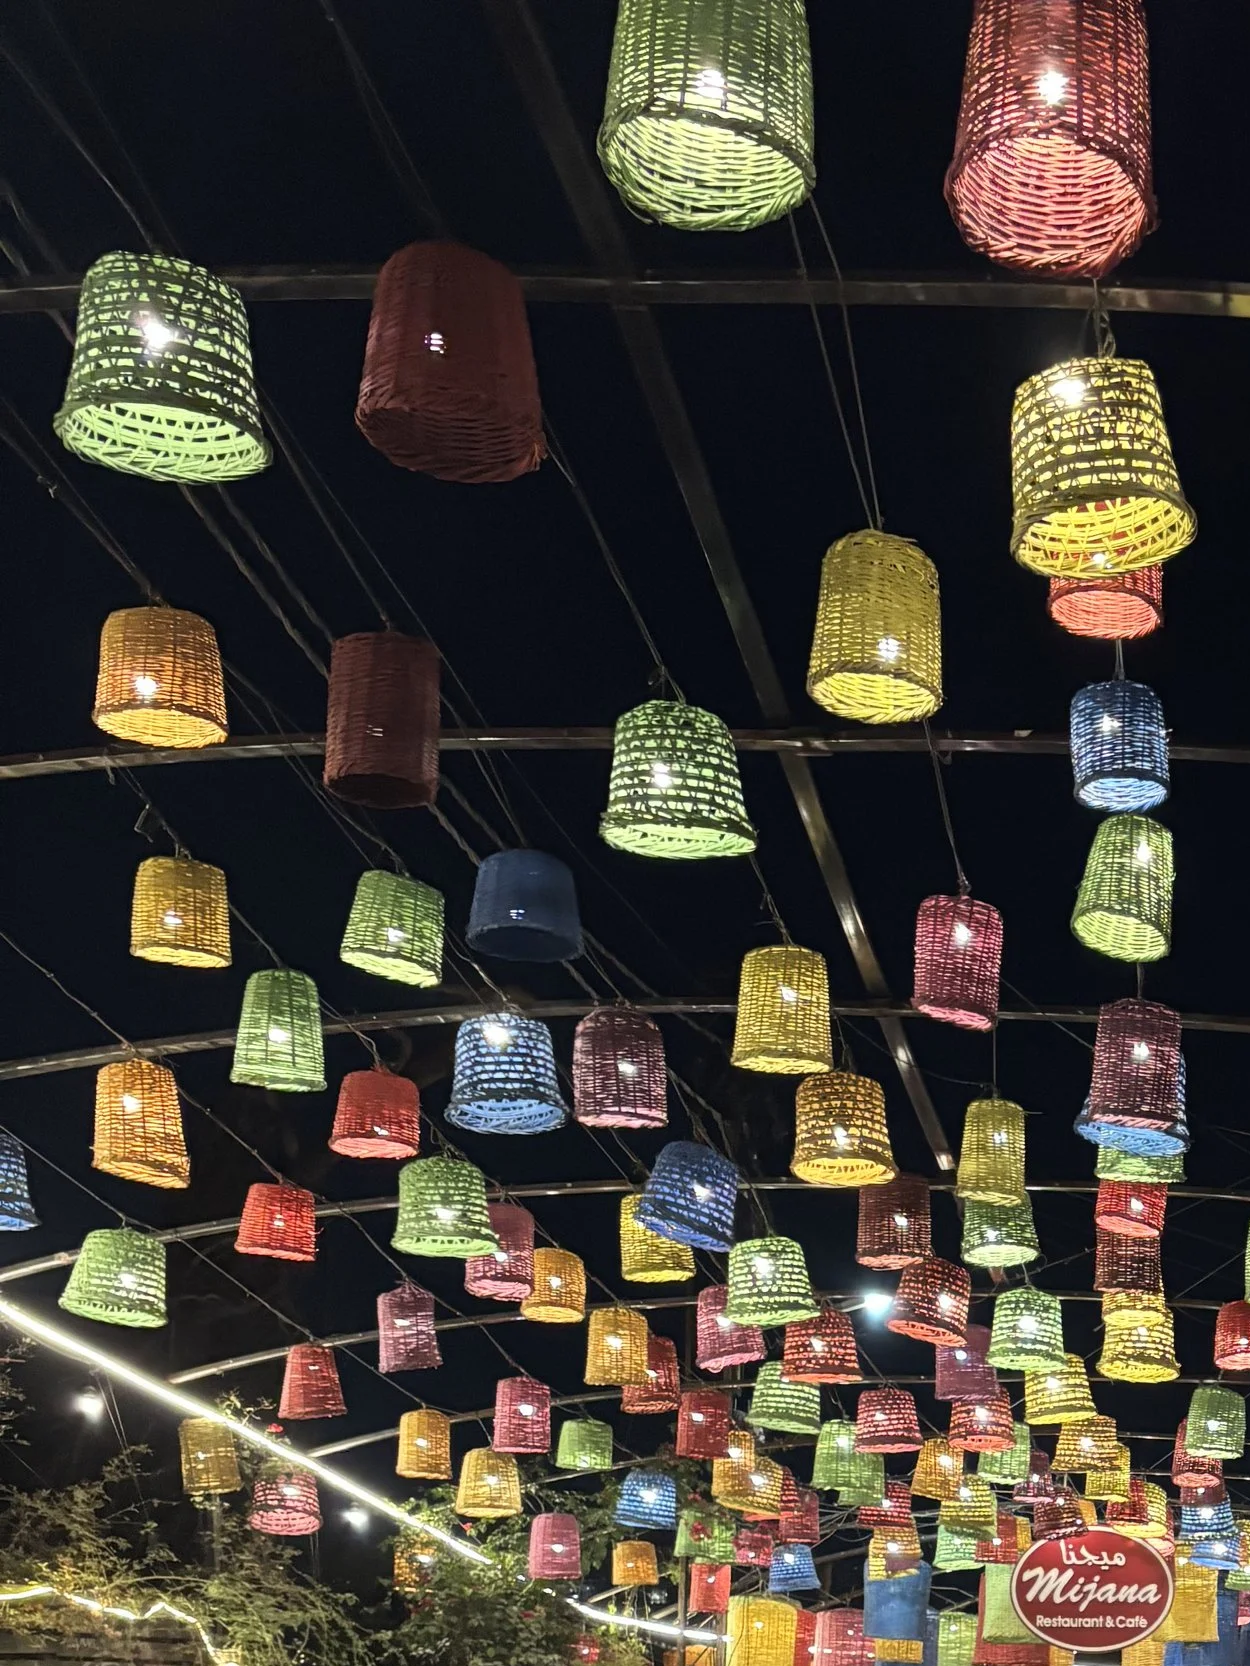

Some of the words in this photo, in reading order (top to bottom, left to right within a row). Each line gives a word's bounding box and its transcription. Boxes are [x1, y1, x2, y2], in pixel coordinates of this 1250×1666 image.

[1059, 1539, 1127, 1571] ميجنا
[1022, 1566, 1162, 1613] Mijana
[1036, 1614, 1104, 1628] Restaurant
[1105, 1615, 1116, 1628] &
[1116, 1614, 1148, 1629] Café
